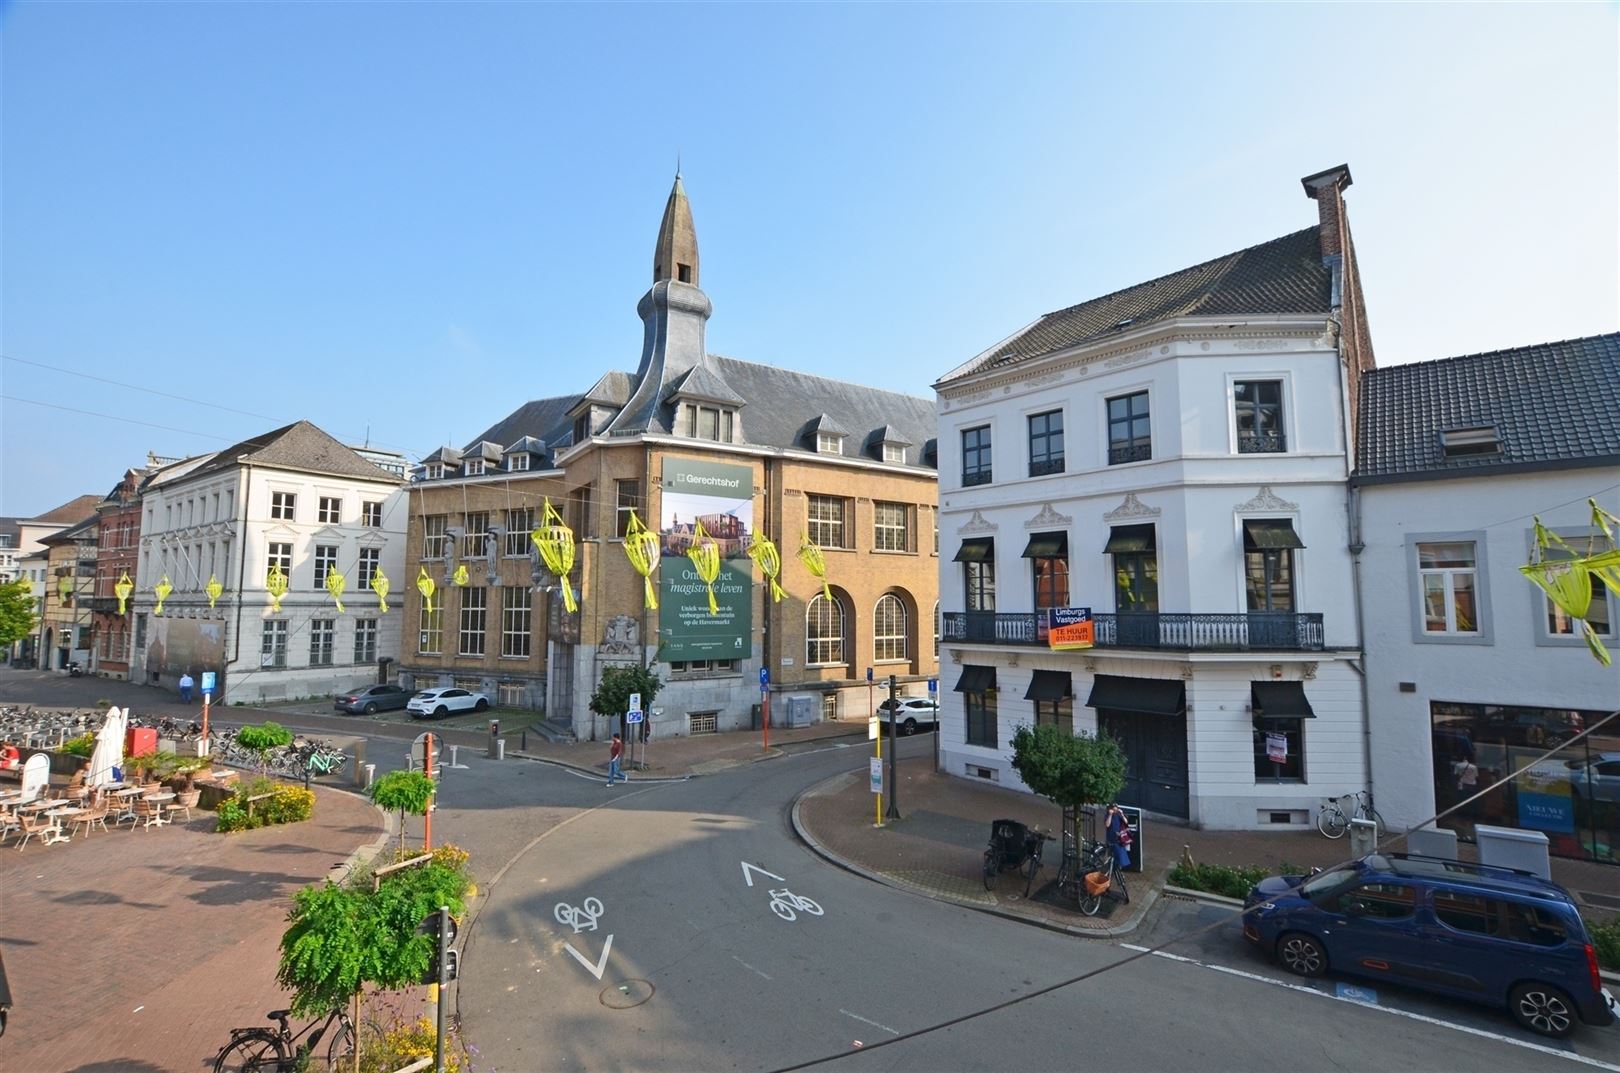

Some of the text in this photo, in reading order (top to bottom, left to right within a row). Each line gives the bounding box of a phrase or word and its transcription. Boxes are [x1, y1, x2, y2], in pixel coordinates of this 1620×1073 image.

[686, 474, 740, 488] Gerechtshof
[719, 571, 733, 581] het
[720, 583, 743, 592] leven
[1056, 608, 1085, 616] Limburgs
[1056, 616, 1086, 624] Vastgoed
